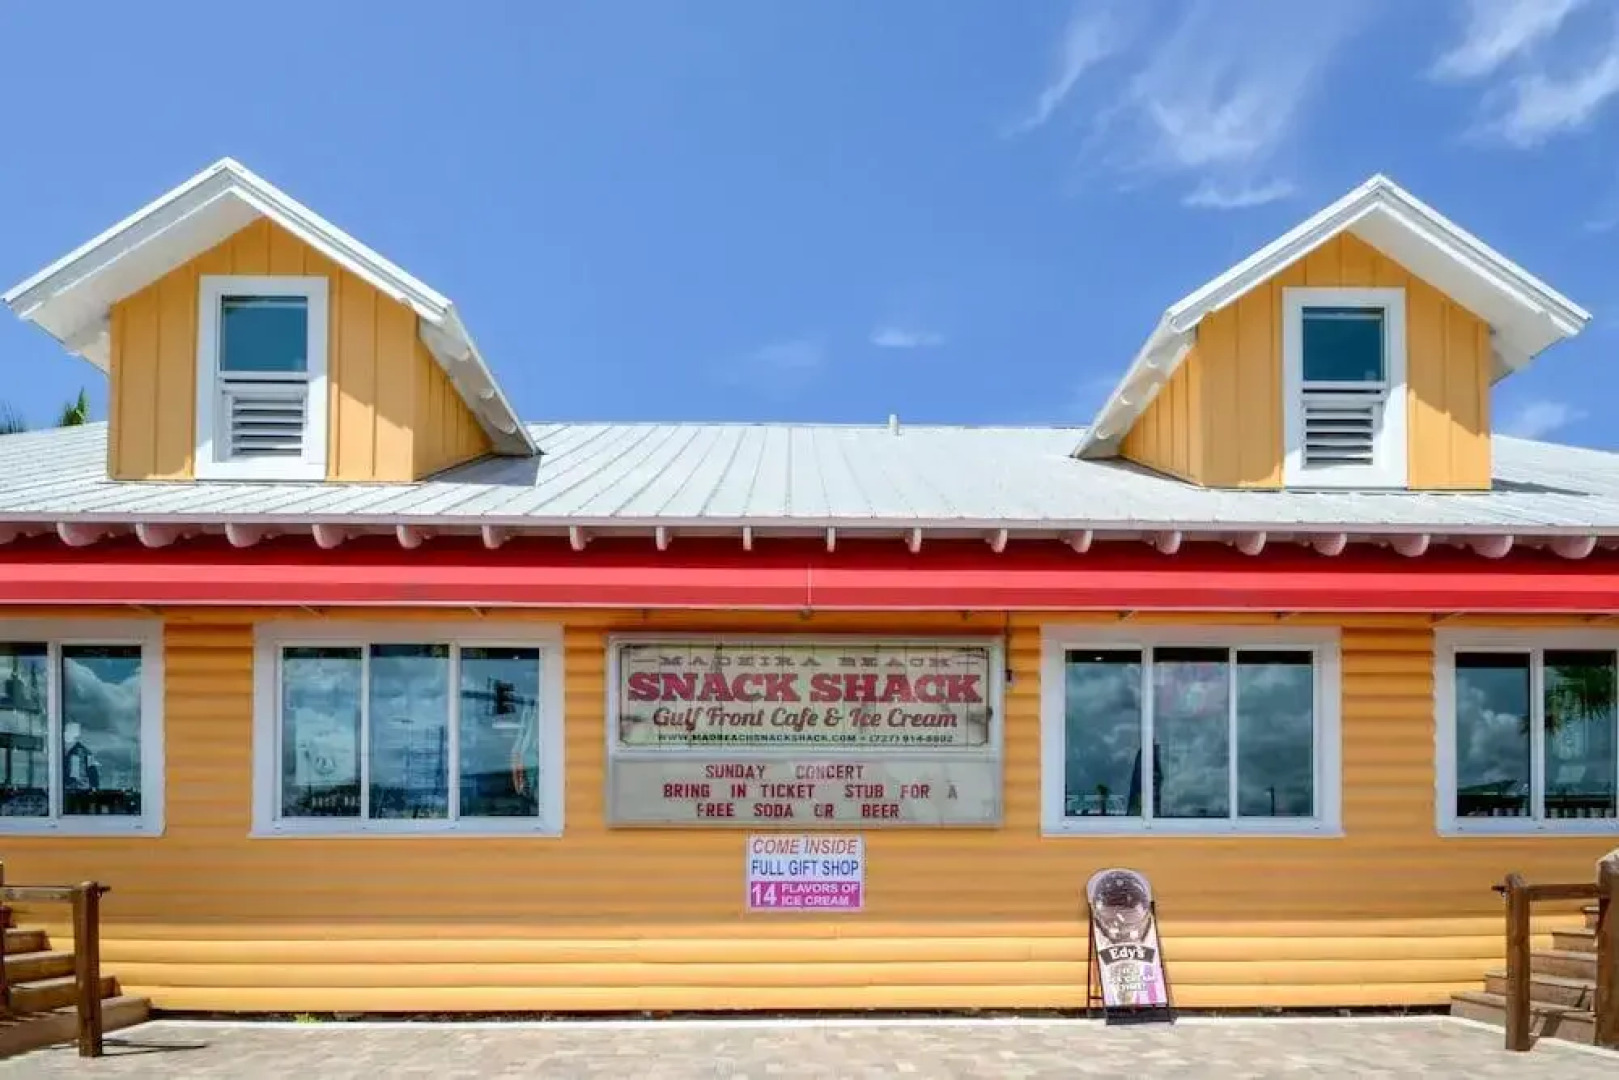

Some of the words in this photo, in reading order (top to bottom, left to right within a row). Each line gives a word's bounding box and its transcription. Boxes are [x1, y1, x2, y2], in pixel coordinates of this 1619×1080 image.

[659, 655, 822, 668] MADEIRA
[837, 655, 951, 668] BEACH
[627, 673, 800, 703] SNACK
[809, 672, 983, 704] SHACK
[653, 706, 703, 732] Gulf
[705, 708, 765, 729] Front
[770, 707, 819, 732] Cafe
[823, 707, 842, 728] &
[848, 708, 881, 729] Ice
[886, 707, 958, 729] Cream
[705, 764, 766, 780] SUNDAY
[795, 764, 865, 780] CONCERT
[662, 783, 711, 799] BRING
[730, 783, 747, 799] IN
[760, 783, 816, 799] TICKET
[844, 783, 885, 799] STUB
[900, 783, 931, 799] FOR
[947, 783, 959, 799] A
[696, 803, 736, 818] FREE
[753, 803, 794, 818] SODA
[861, 803, 901, 818] BEER
[752, 838, 800, 854] COME
[804, 838, 858, 854] INSIDE
[751, 859, 785, 876] FULL
[788, 859, 819, 876] GIFT
[822, 859, 860, 876] SHOP
[752, 884, 778, 906] 14
[781, 883, 837, 893] FLAVORS
[841, 883, 859, 893] OF
[781, 896, 801, 906] ICE
[804, 896, 850, 906] CREAM
[1109, 947, 1146, 959] Edy's
